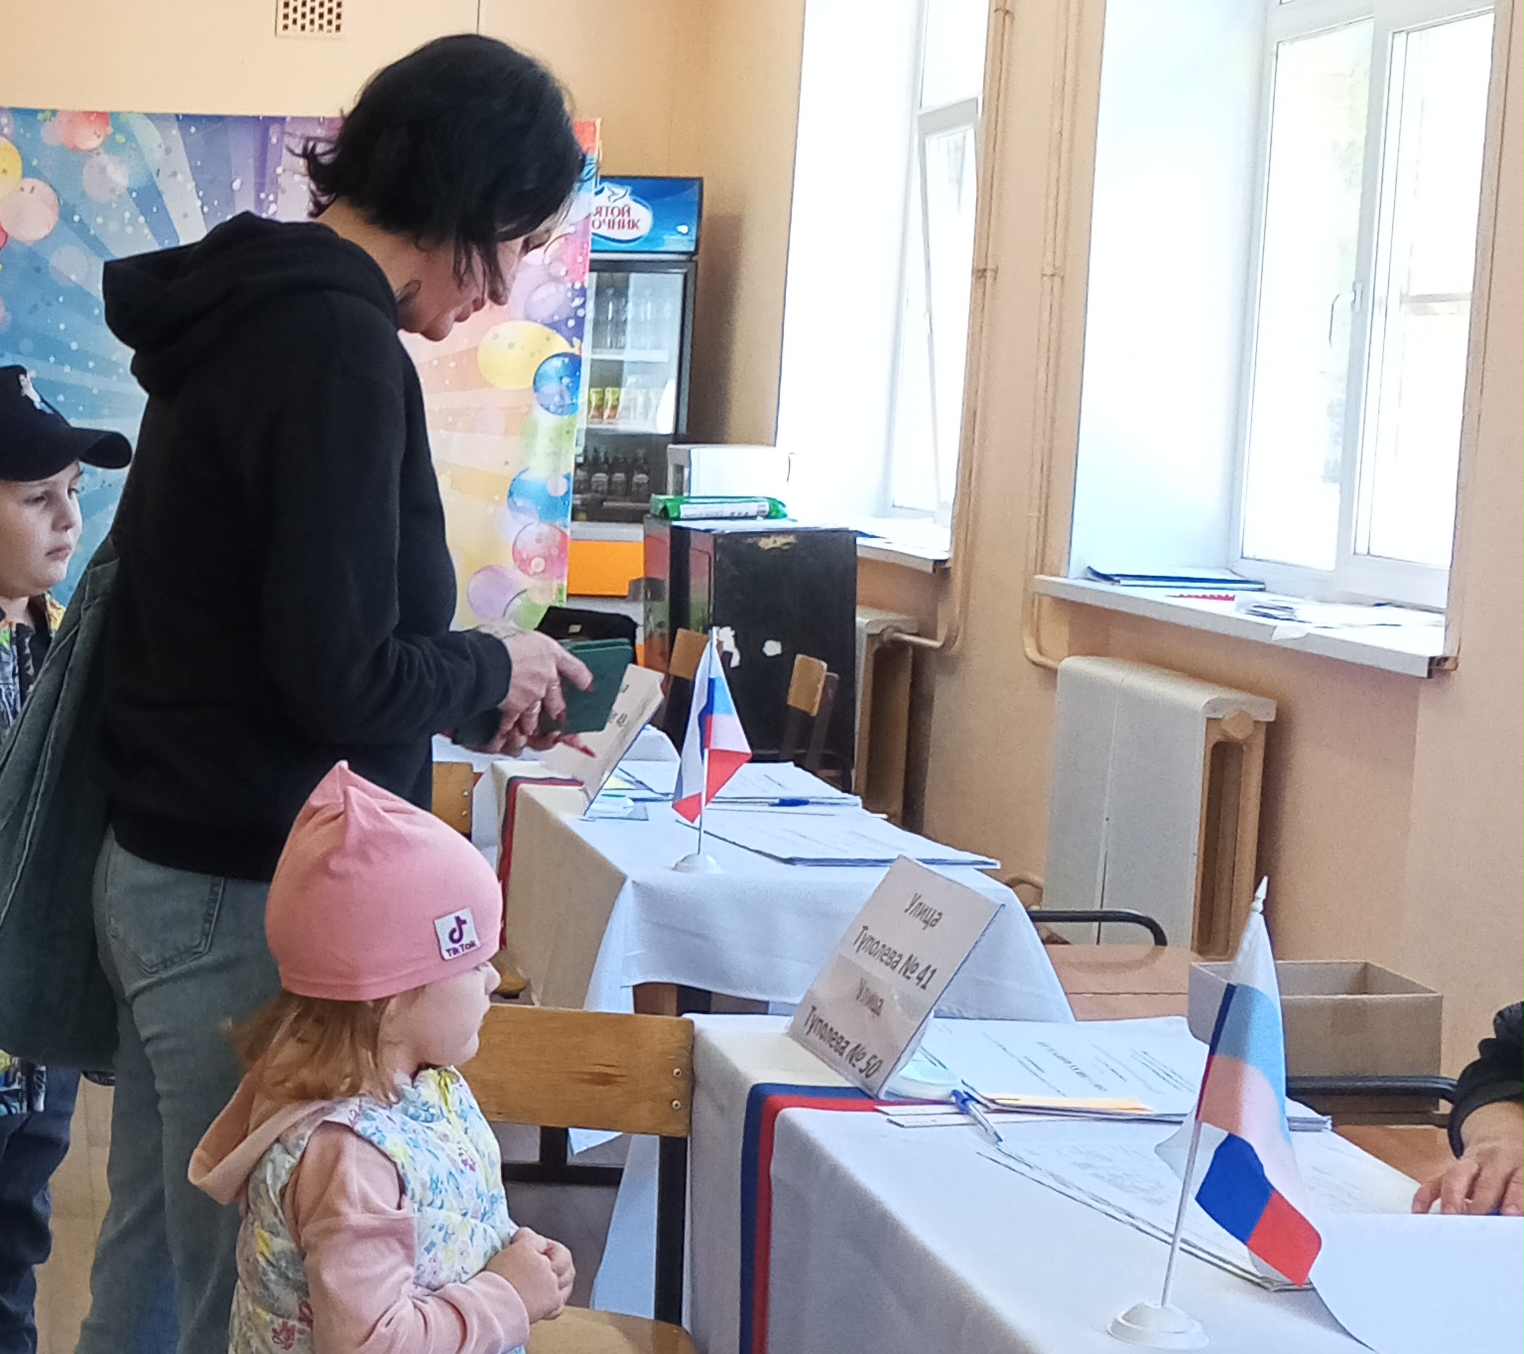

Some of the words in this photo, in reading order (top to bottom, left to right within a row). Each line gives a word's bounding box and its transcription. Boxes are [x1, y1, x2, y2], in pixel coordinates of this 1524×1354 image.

[591, 218, 640, 231] ОЧНИК
[593, 204, 631, 218] ЯТОЙ
[904, 892, 943, 931] Улица
[853, 925, 903, 971] Туполева
[915, 964, 938, 990] 41
[804, 1005, 851, 1057] Туполева
[858, 1054, 883, 1079] 50
